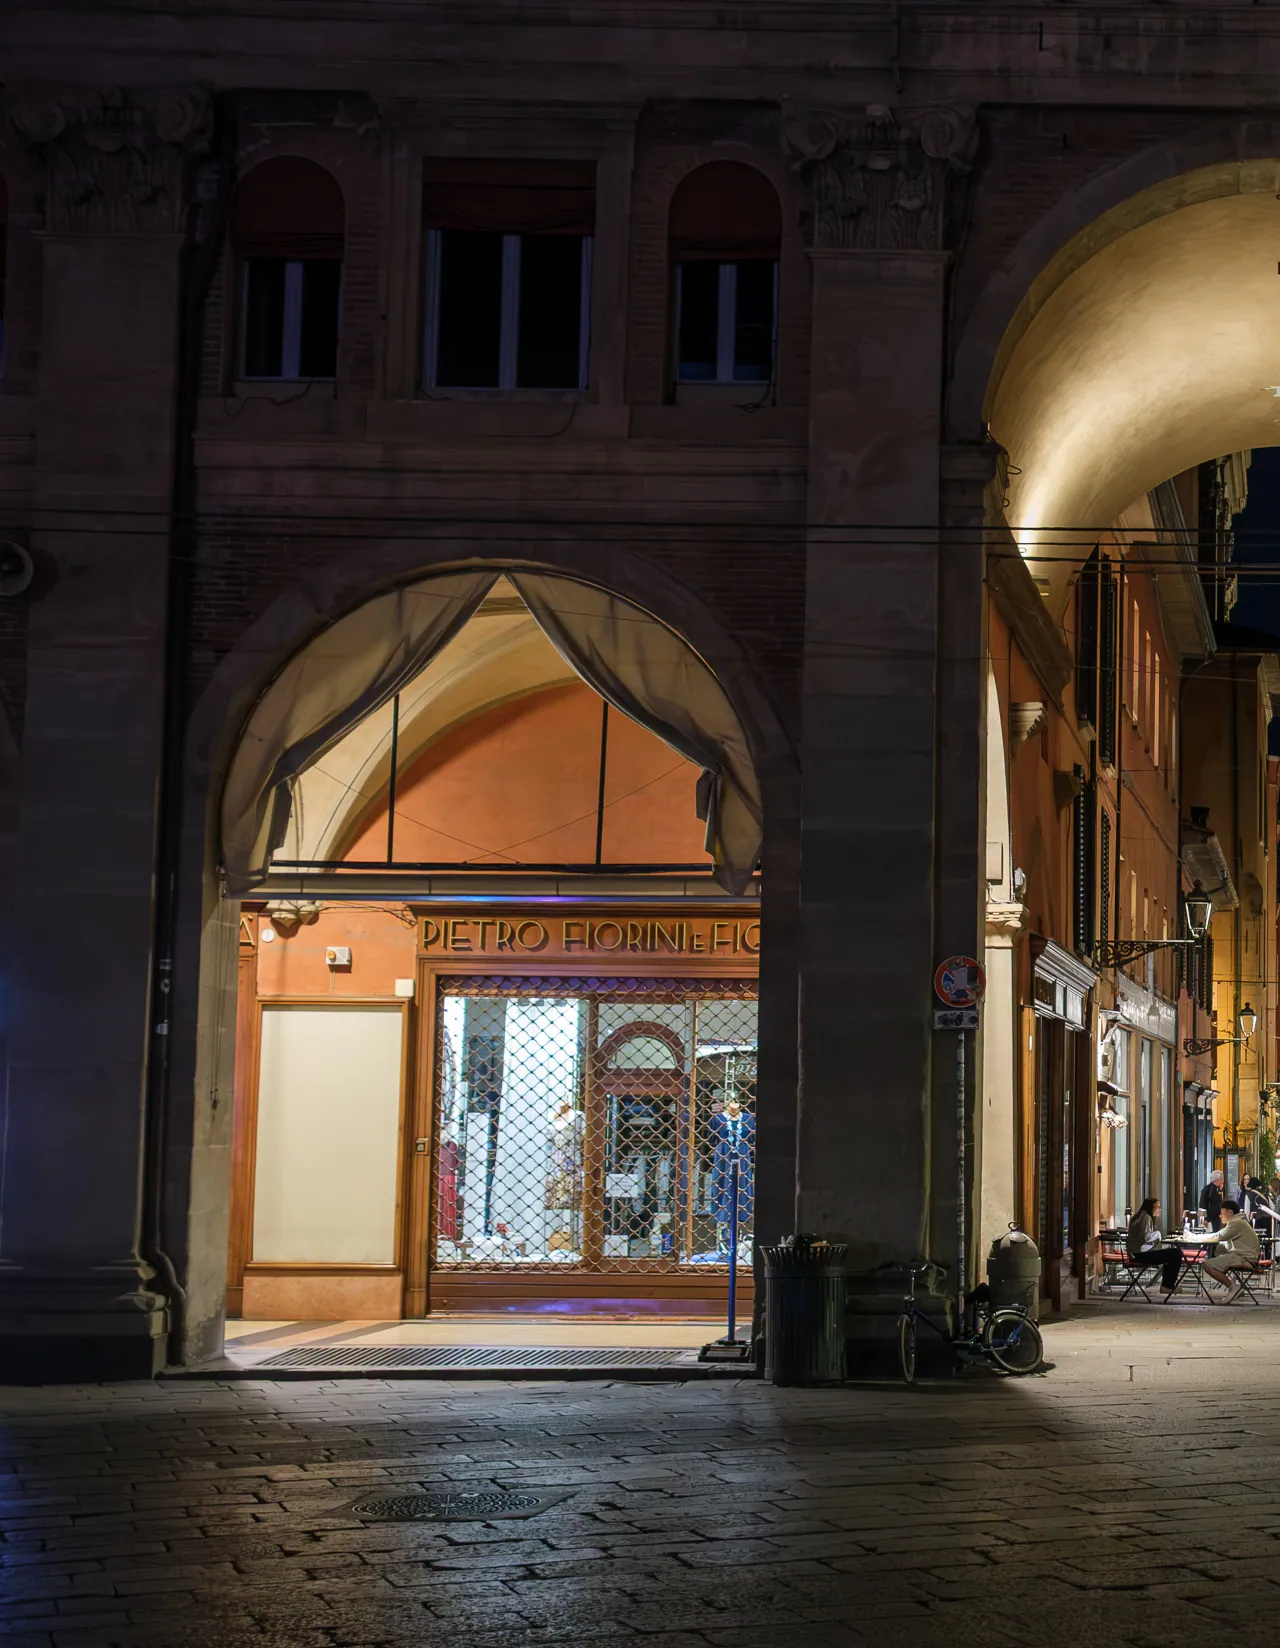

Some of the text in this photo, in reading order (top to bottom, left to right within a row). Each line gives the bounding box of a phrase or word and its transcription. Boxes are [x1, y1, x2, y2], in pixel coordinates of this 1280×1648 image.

[422, 918, 546, 951] PIETRO
[562, 920, 687, 951] FIORINI
[693, 932, 706, 950] E
